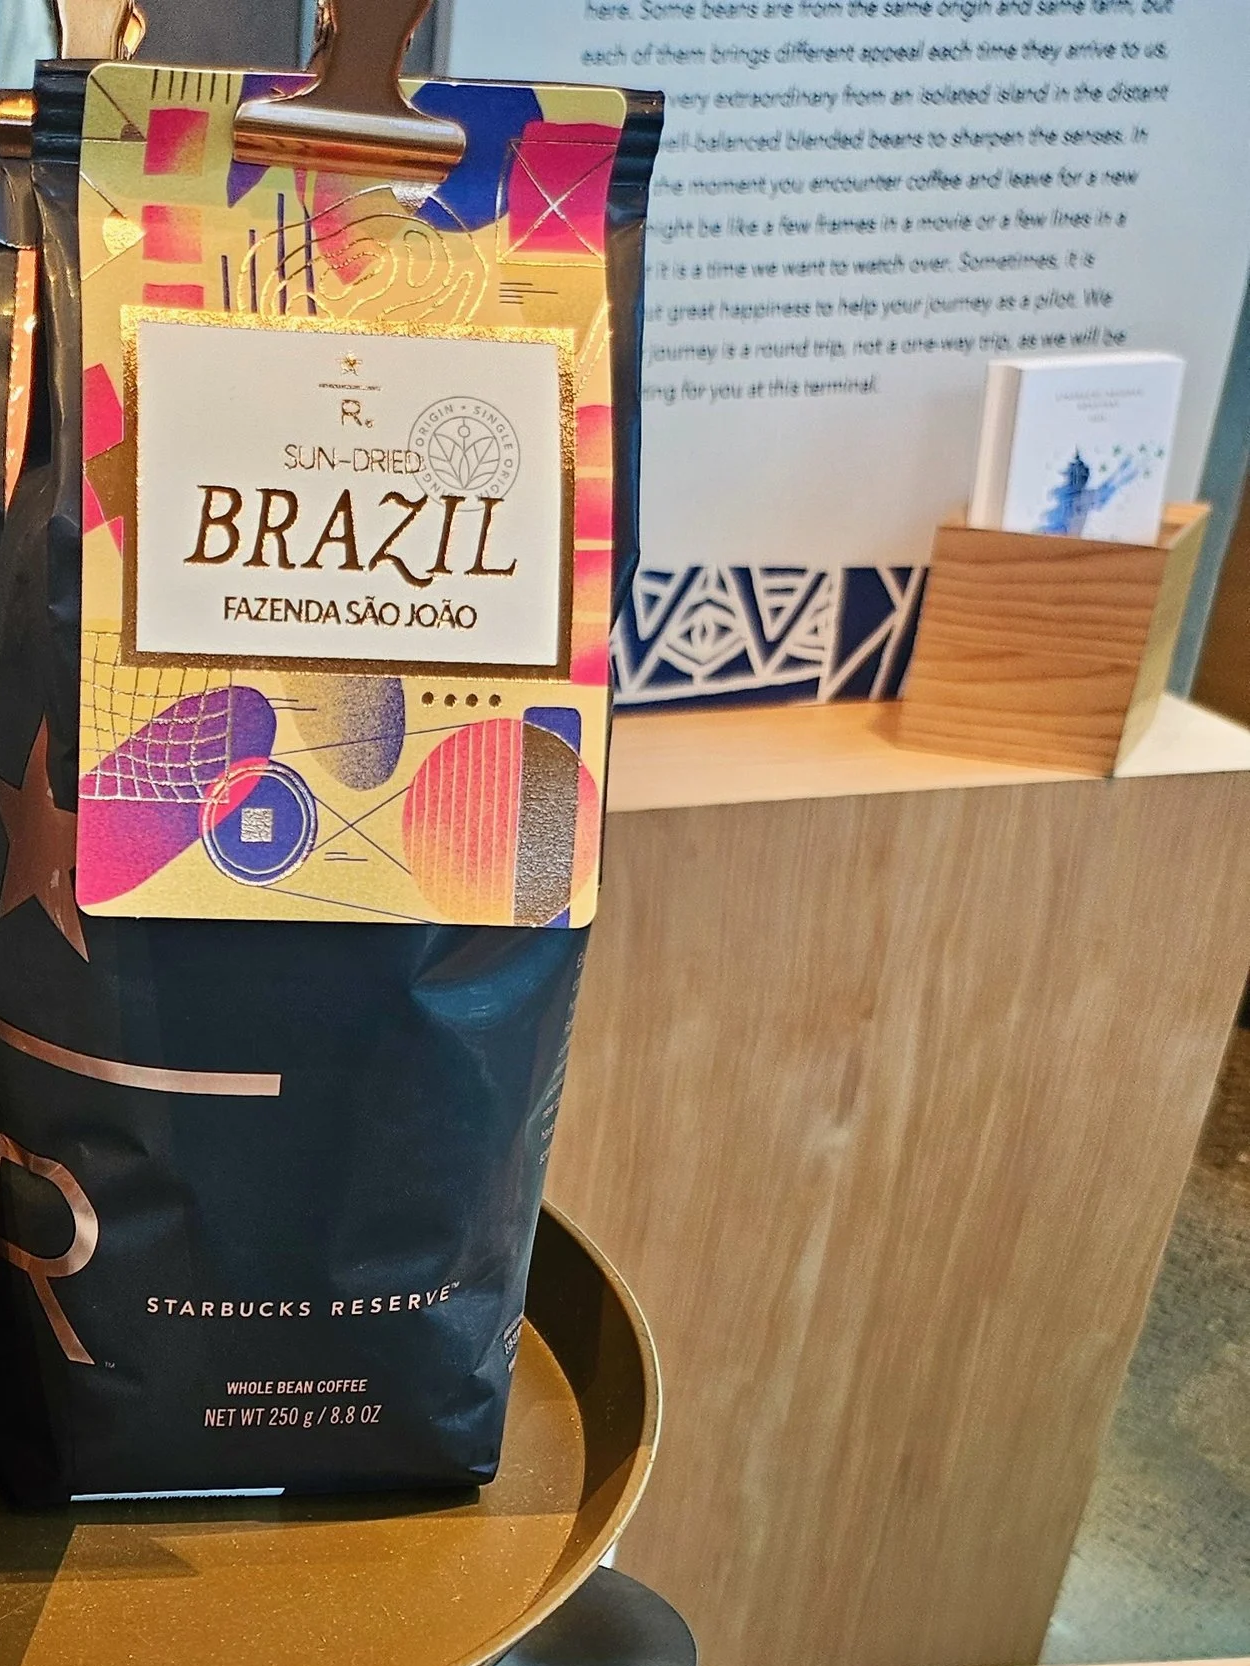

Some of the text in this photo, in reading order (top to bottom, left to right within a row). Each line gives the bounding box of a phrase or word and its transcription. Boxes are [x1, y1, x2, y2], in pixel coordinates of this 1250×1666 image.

[711, 42, 773, 69] brings
[775, 38, 855, 64] different
[858, 39, 925, 67] appeal
[928, 39, 971, 61] each
[976, 39, 1017, 61] time
[1022, 38, 1062, 65] they
[1065, 39, 1117, 61] arrive
[714, 84, 839, 113] extraordinary
[1106, 79, 1169, 102] distant
[785, 125, 865, 151] blended
[868, 126, 924, 150] beans
[951, 124, 1024, 153] sharpen
[689, 167, 1053, 197] moment encounter coffee leave
[815, 208, 1093, 235] frames movie lines
[852, 253, 905, 275] watch
[666, 300, 714, 327] great
[719, 298, 812, 324] happiness
[837, 293, 879, 321] help
[923, 294, 993, 320] journey
[755, 335, 810, 359] round
[415, 404, 514, 450] ORIGIN SINGLE
[283, 443, 423, 476] SUN-DRIED
[183, 484, 519, 590] BRAZIL
[223, 596, 479, 631] FAZENDA SÃO JOÃO
[146, 1296, 312, 1319] STARBUCKS
[226, 1378, 368, 1397] WHOLE BEAN COFFEE
[204, 1408, 237, 1429] NET
[240, 1408, 265, 1428] WT
[268, 1407, 300, 1428] 250
[303, 1410, 315, 1430] g
[330, 1405, 356, 1425] 8.8
[360, 1404, 383, 1425] OZ
